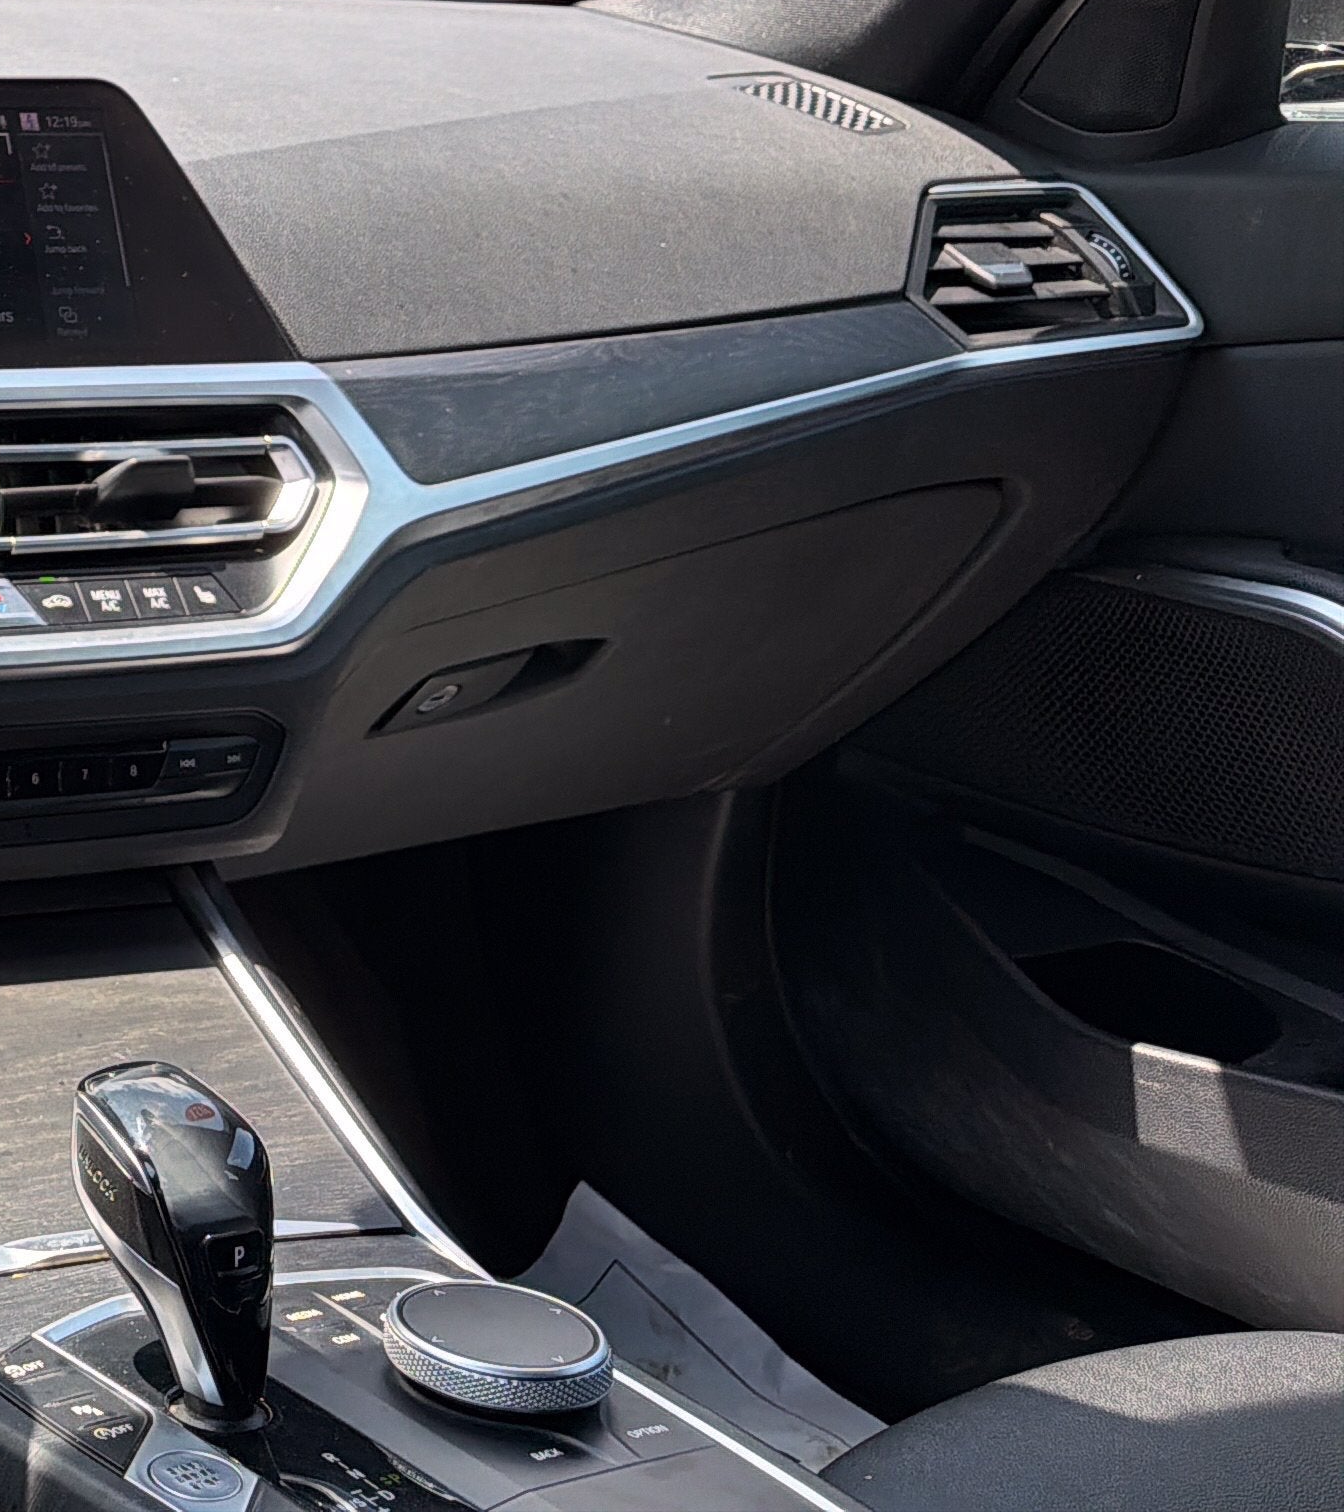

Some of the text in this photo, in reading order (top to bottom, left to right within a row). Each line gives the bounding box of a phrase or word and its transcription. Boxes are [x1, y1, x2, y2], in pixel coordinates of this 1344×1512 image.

[90, 590, 121, 601] MENU
[142, 587, 168, 598] MAX
[31, 772, 40, 785] 6
[81, 768, 89, 780] 7
[129, 764, 138, 777] 8
[78, 1144, 118, 1202] UNLOCK
[234, 1245, 245, 1268] P
[22, 1359, 45, 1372] OFF
[111, 1423, 135, 1437] OFF
[626, 1424, 670, 1439] OPTION
[321, 1452, 340, 1464] R
[529, 1447, 565, 1461] BACK
[345, 1468, 366, 1480] N
[378, 1490, 395, 1501] D
